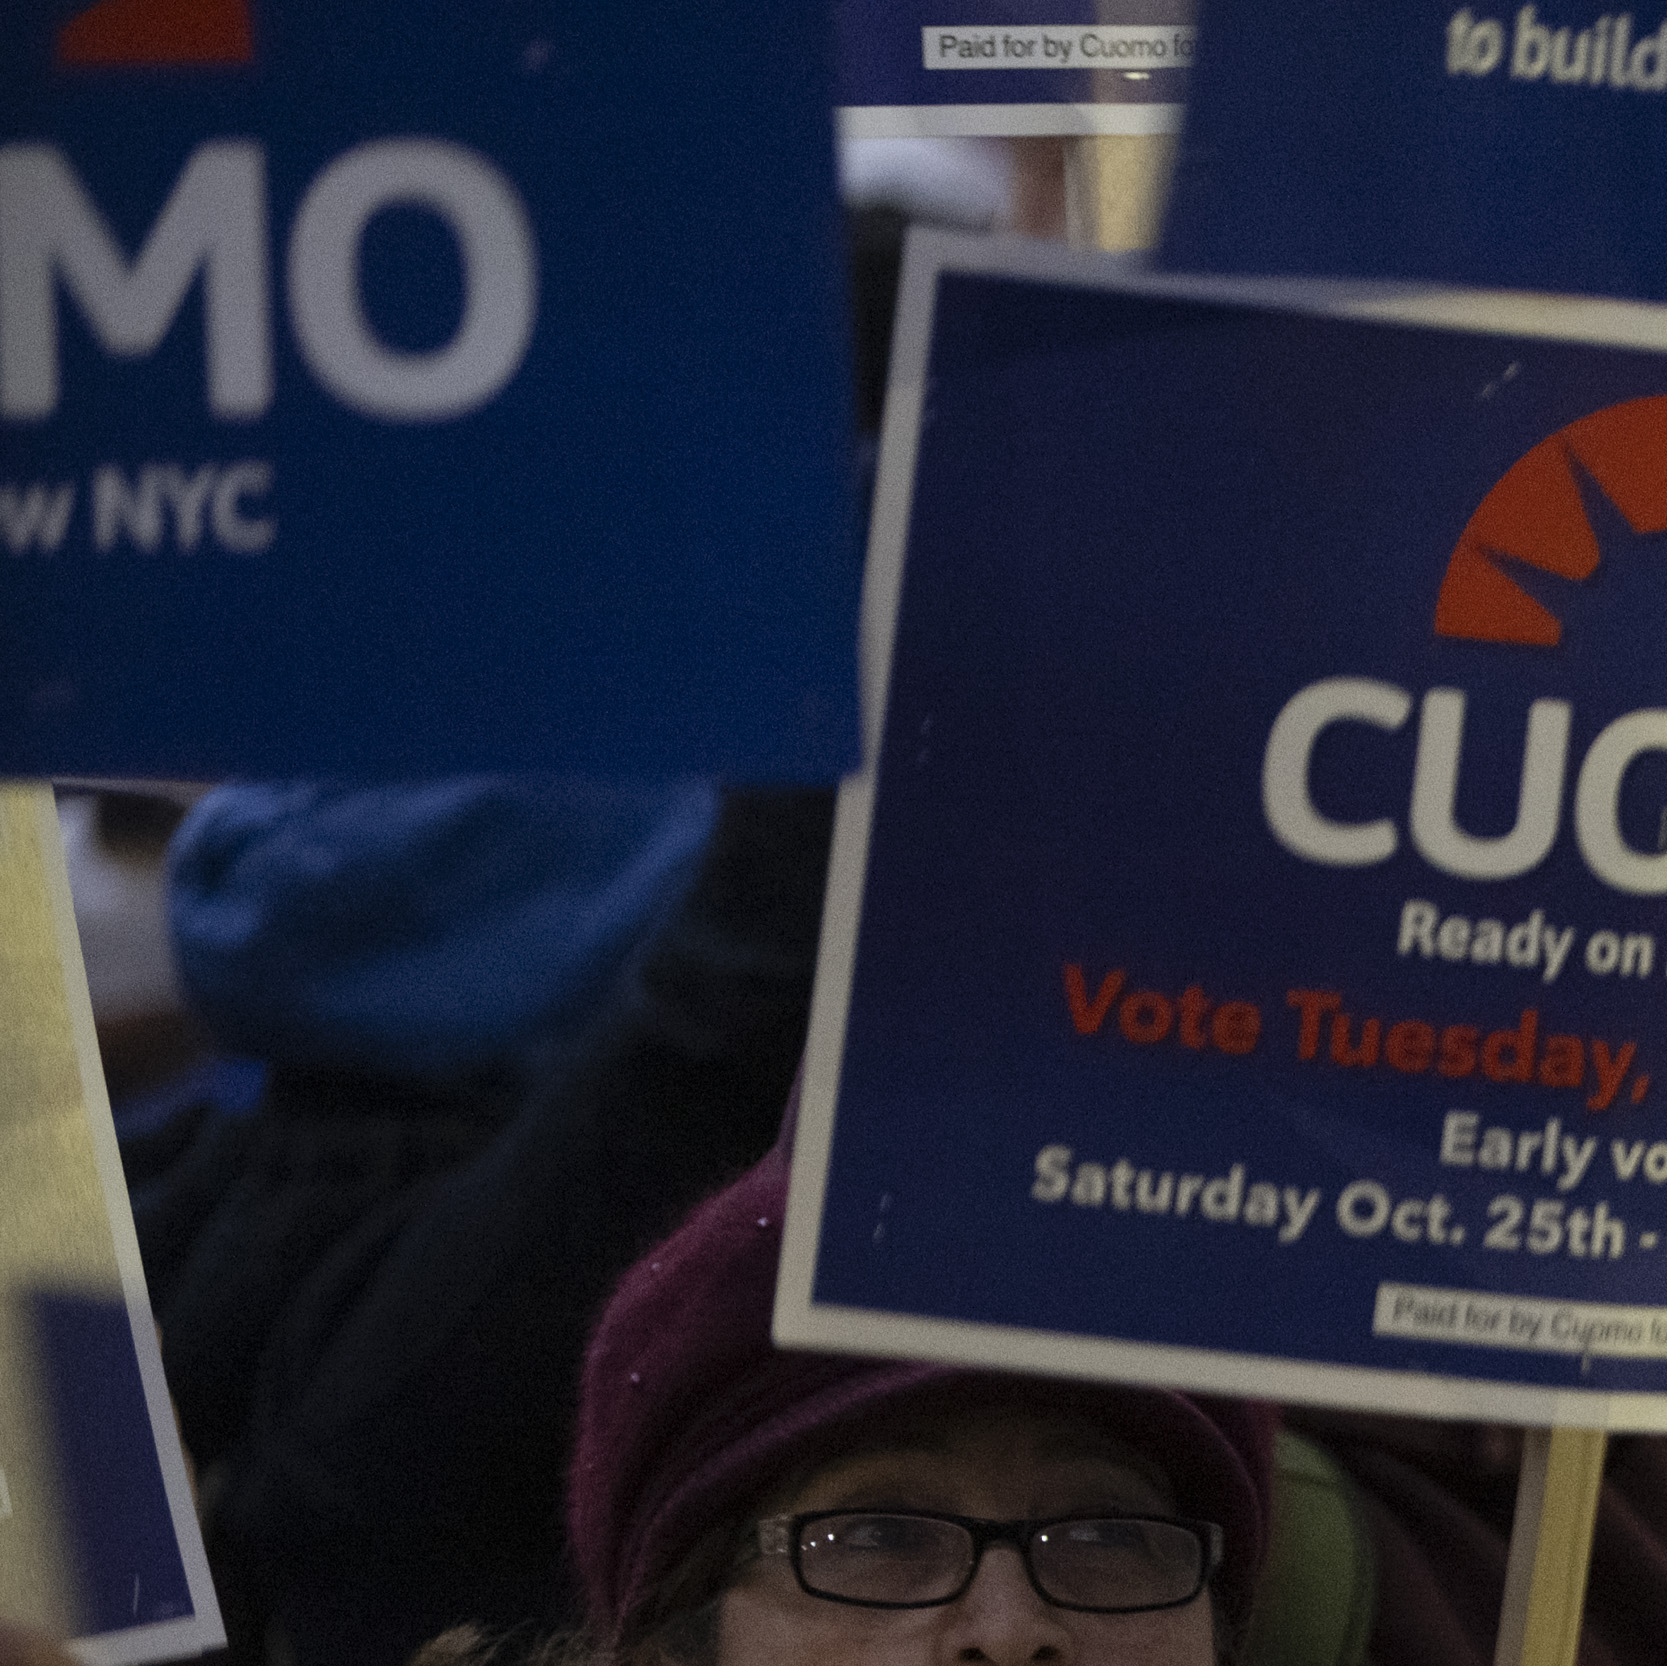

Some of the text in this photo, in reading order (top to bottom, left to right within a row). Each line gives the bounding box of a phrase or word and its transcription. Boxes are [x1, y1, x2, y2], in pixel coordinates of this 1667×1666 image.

[938, 33, 1195, 64] Paid for by Cuomo fo
[1446, 9, 1503, 76] to
[94, 462, 274, 556] NYC
[1398, 899, 1574, 984] Ready
[1585, 929, 1652, 977] on
[1061, 962, 1263, 1057] Vote
[1287, 989, 1650, 1112] Tuesday,
[1438, 1110, 1597, 1192] Early
[1031, 1142, 1322, 1247] Saturday
[1336, 1177, 1467, 1246] Oct.
[1483, 1194, 1626, 1260] 25th
[1393, 1294, 1457, 1331] Paid
[1508, 1305, 1543, 1340] by
